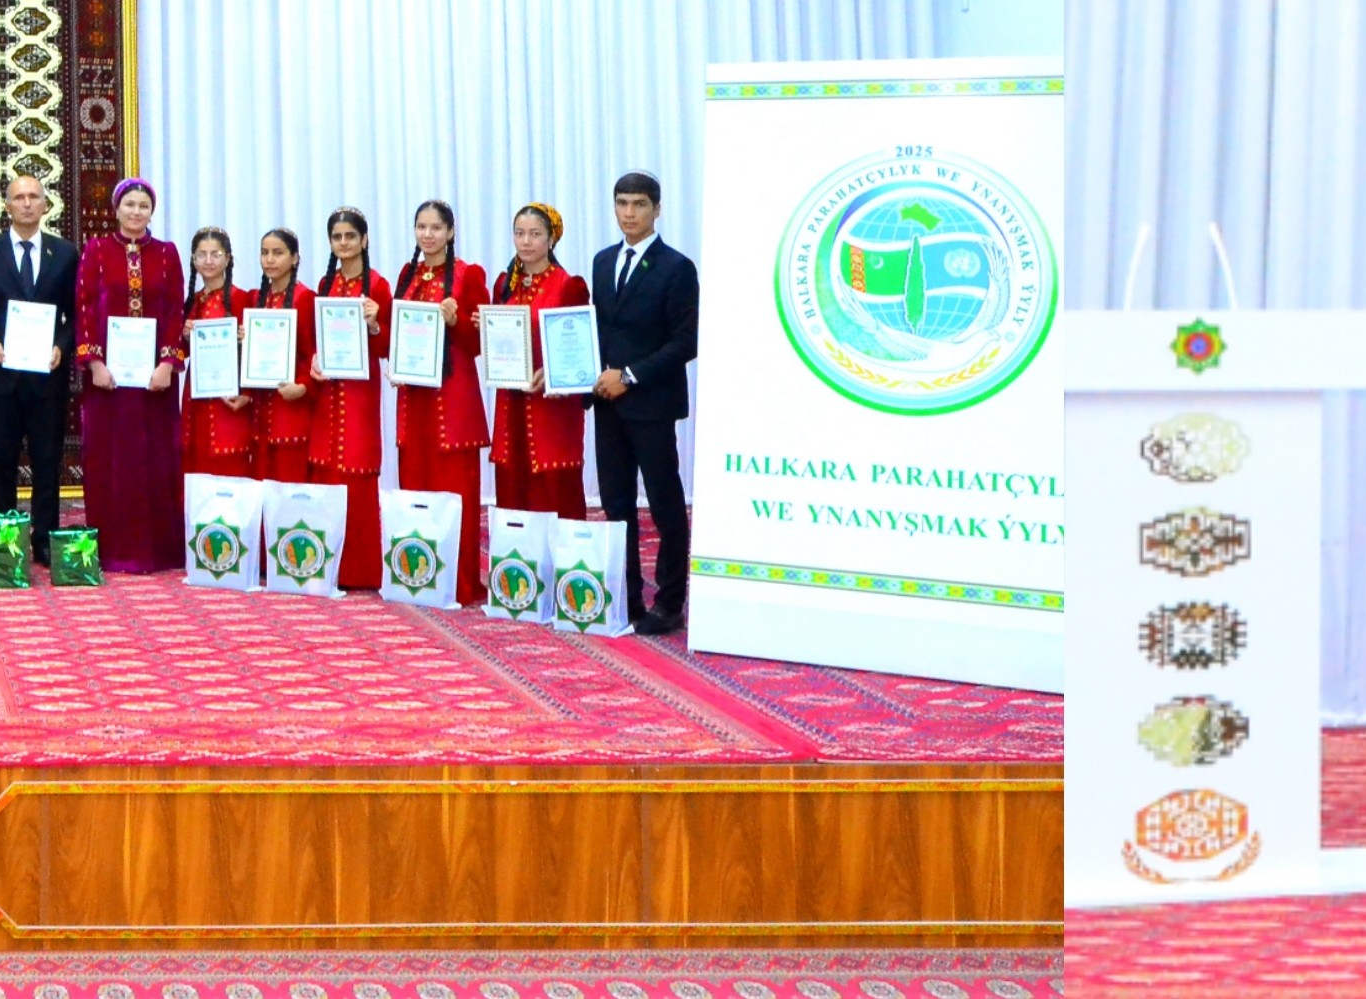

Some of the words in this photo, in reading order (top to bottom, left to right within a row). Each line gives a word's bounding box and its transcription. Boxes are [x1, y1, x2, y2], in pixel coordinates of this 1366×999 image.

[895, 145, 933, 158] 2025
[797, 243, 816, 320] HALKARA
[808, 164, 922, 234] PARAHATÇYLYK
[936, 167, 961, 183] WE
[1012, 283, 1037, 327] ÝYLY
[725, 454, 857, 481] HALKARA
[871, 464, 1064, 499] PARAHATÇYL
[751, 499, 793, 521] WE
[807, 503, 988, 538] YNANYŞMAK
